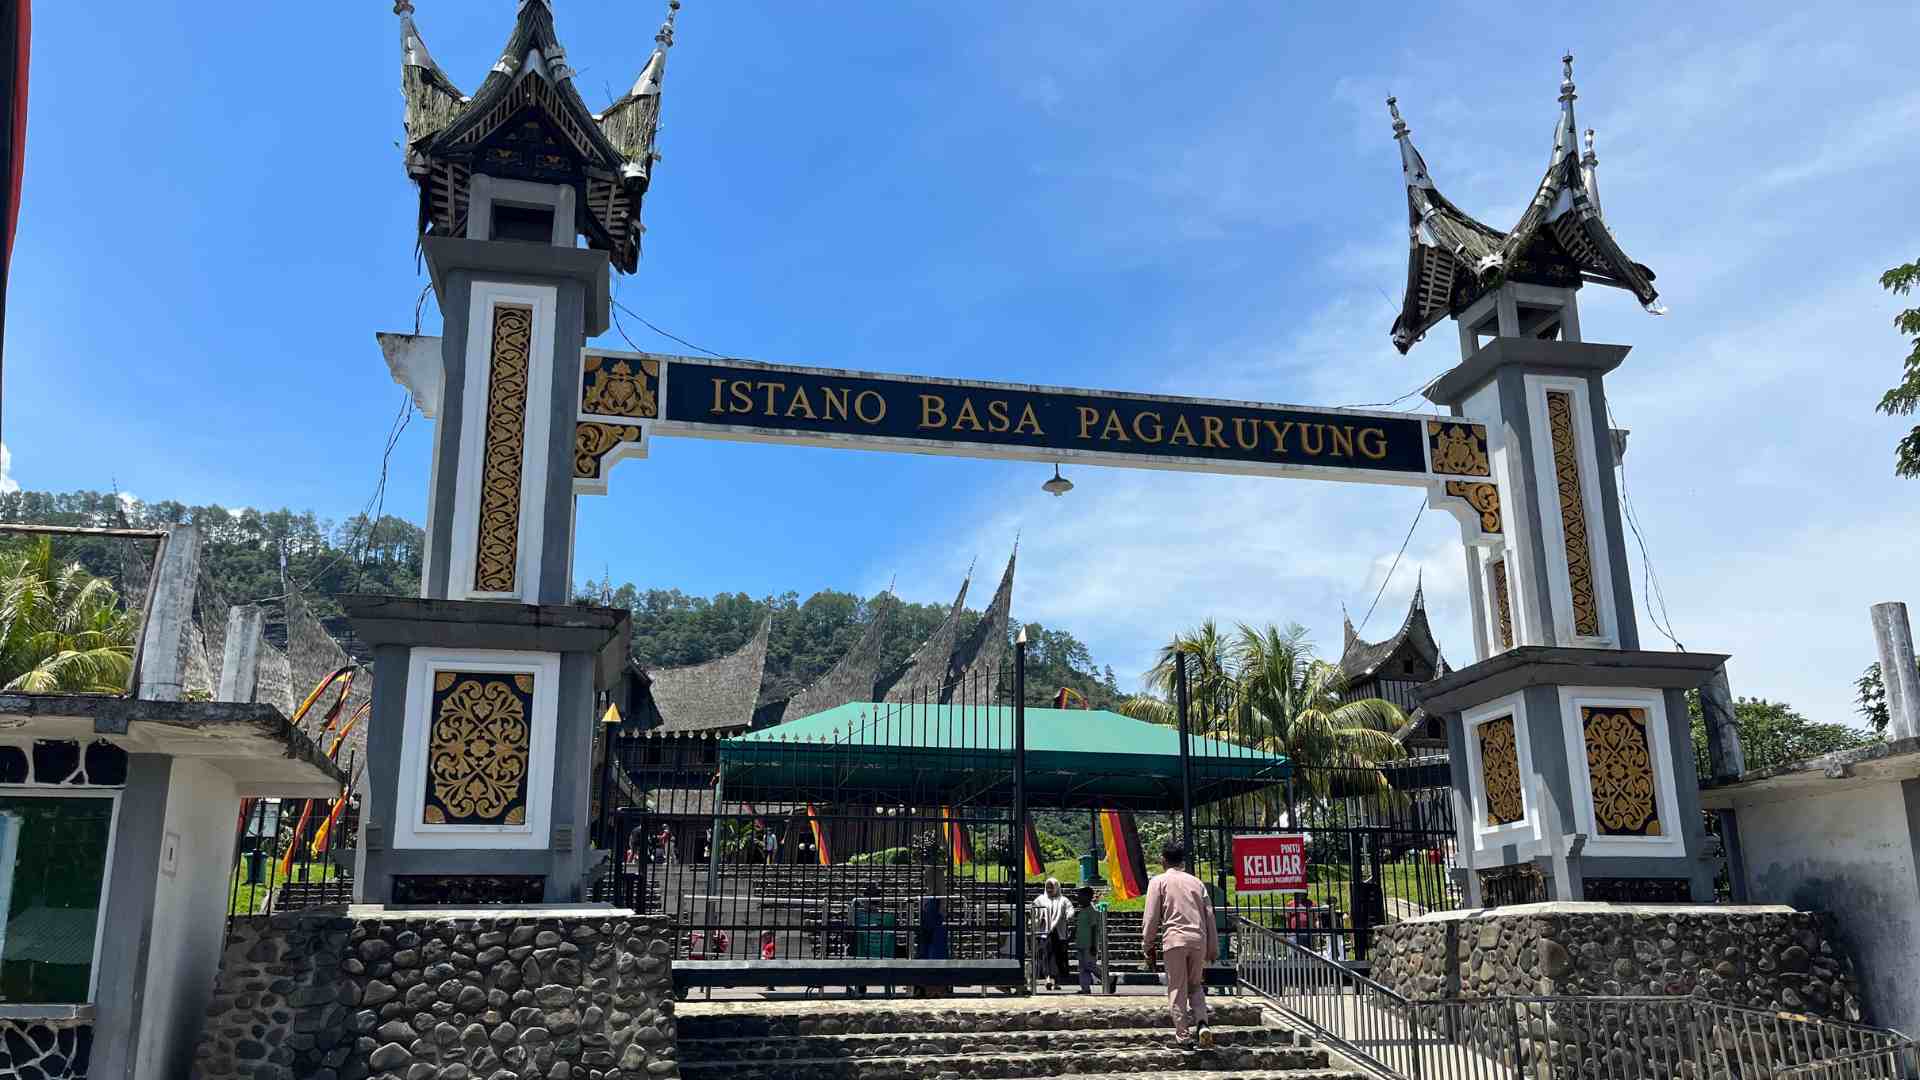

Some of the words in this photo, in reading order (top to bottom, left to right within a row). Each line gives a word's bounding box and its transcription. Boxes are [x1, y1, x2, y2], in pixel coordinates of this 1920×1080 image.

[710, 378, 887, 424] ISTANO
[918, 394, 1045, 435] BASA
[1076, 406, 1388, 459] PAGARUYUNG
[1243, 855, 1301, 876] KELUAR
